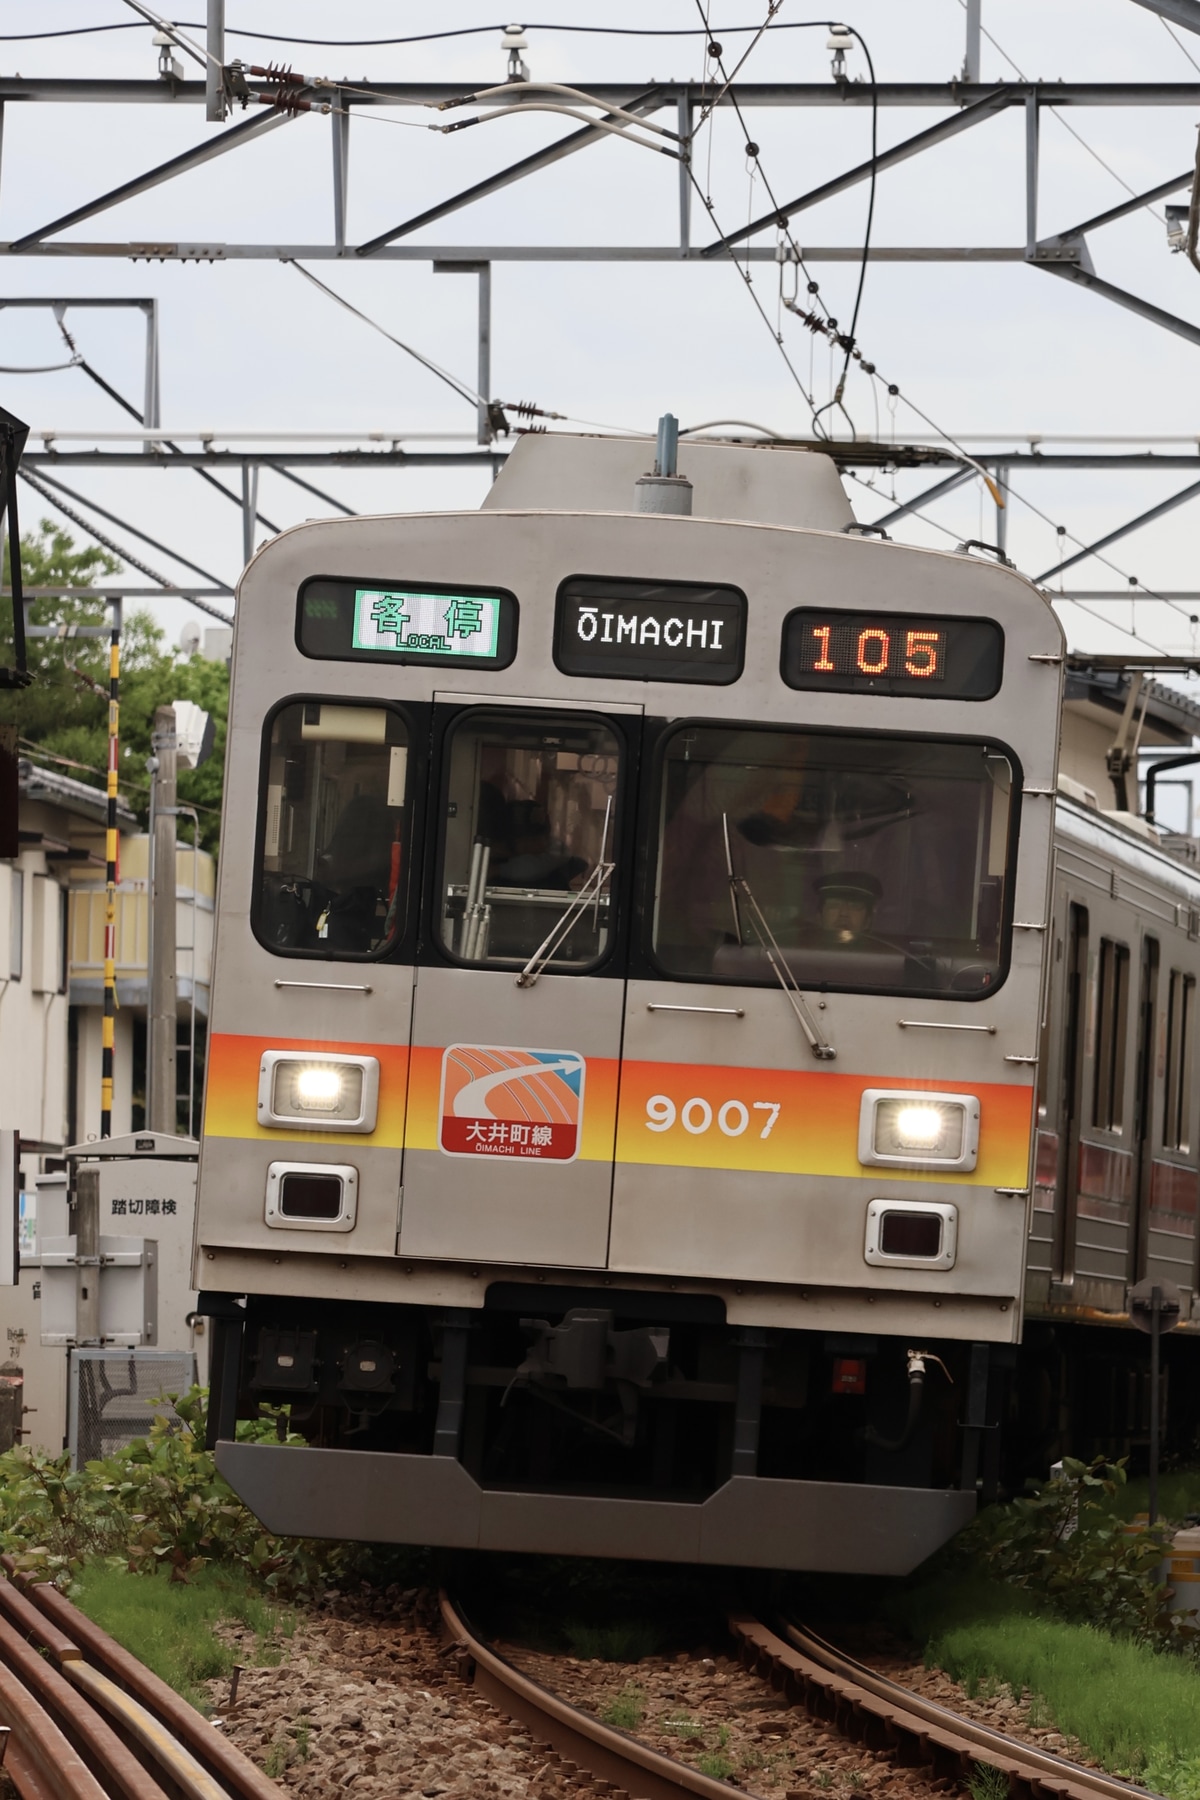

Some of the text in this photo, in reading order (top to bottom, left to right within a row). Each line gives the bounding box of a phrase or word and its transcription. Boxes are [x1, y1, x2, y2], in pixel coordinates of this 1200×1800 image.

[371, 596, 484, 639] 各停
[577, 606, 725, 650] ŌIMACHI
[396, 634, 452, 650] LOCAL
[812, 626, 940, 677] 105
[465, 1121, 553, 1146] 大井町線
[645, 1094, 781, 1140] 9007
[520, 1147, 542, 1156] LINE
[111, 1198, 177, 1216] 踏切障検
